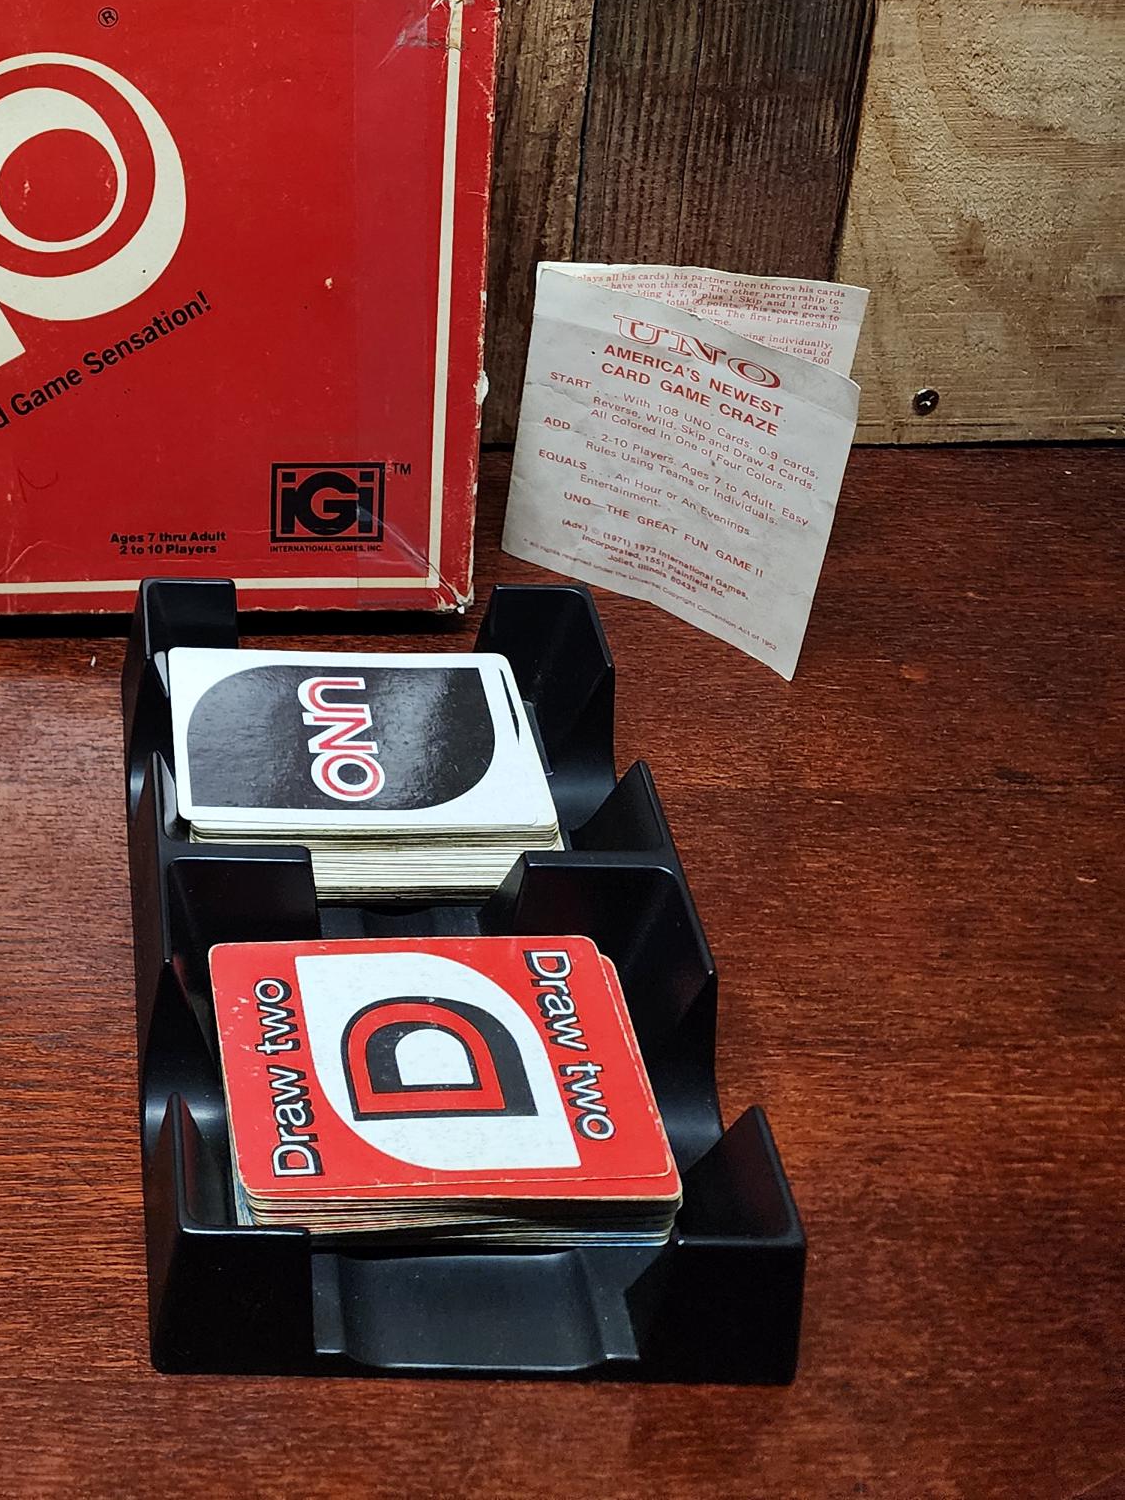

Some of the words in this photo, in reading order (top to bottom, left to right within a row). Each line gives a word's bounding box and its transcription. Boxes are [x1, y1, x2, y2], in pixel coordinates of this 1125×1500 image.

[691, 274, 731, 285] partner
[734, 280, 757, 288] then
[760, 283, 795, 291] throws
[799, 285, 813, 293] his
[818, 288, 845, 298] cards
[710, 284, 728, 293] The
[732, 288, 760, 296] other
[764, 292, 825, 304] partnership
[11, 368, 83, 417] Game
[82, 290, 213, 377] Sensation!
[604, 345, 700, 382] AMERICA'S
[710, 379, 783, 416] NEWEST
[613, 315, 780, 389] UNO
[550, 371, 592, 389] START
[624, 393, 651, 409] With
[658, 404, 679, 417] 108
[684, 414, 712, 431] UNO
[602, 363, 650, 385] CARD
[660, 380, 711, 407] GAME
[719, 404, 779, 437] CRAZE
[538, 449, 587, 470] EQUALS
[615, 473, 630, 485] An
[635, 479, 662, 495] Hour
[667, 491, 677, 500] or
[681, 498, 696, 511] An
[543, 416, 571, 430] ADD
[601, 434, 628, 452] 2-10
[682, 462, 710, 482] Ages
[714, 476, 721, 484] 7
[725, 482, 737, 493] to
[782, 507, 809, 526] Easy
[586, 440, 617, 457] Rules
[621, 452, 654, 471] Using
[659, 463, 694, 486] Teams
[697, 484, 710, 493] or
[713, 489, 778, 525] Individuals.
[591, 409, 610, 421] All
[611, 413, 655, 437] Colored
[675, 435, 698, 451] One
[701, 447, 714, 457] of
[715, 452, 741, 473] Four
[745, 465, 786, 492] Colors.
[681, 425, 706, 442] Skip
[708, 437, 730, 454] and
[733, 449, 763, 468] Draw
[766, 463, 775, 472] 4
[580, 474, 662, 507] Entertainment.
[110, 532, 146, 545] Ages
[148, 532, 155, 542] 7
[159, 532, 187, 542] thru
[190, 531, 226, 542] Adult
[119, 545, 128, 555] 2
[131, 545, 145, 554] to
[147, 544, 162, 554] 10
[167, 544, 217, 555] Players
[270, 545, 333, 553] INTERNATIONAL
[635, 543, 657, 553] 1973
[658, 549, 713, 581] International
[637, 515, 678, 535] GREAT
[684, 533, 709, 551] FUN
[715, 549, 752, 572] GAME
[297, 677, 385, 802] UNO
[255, 978, 301, 1055] two
[522, 950, 588, 1051] Draw
[559, 1061, 616, 1141] two
[341, 995, 539, 1121] D
[266, 1065, 323, 1177] Draw
